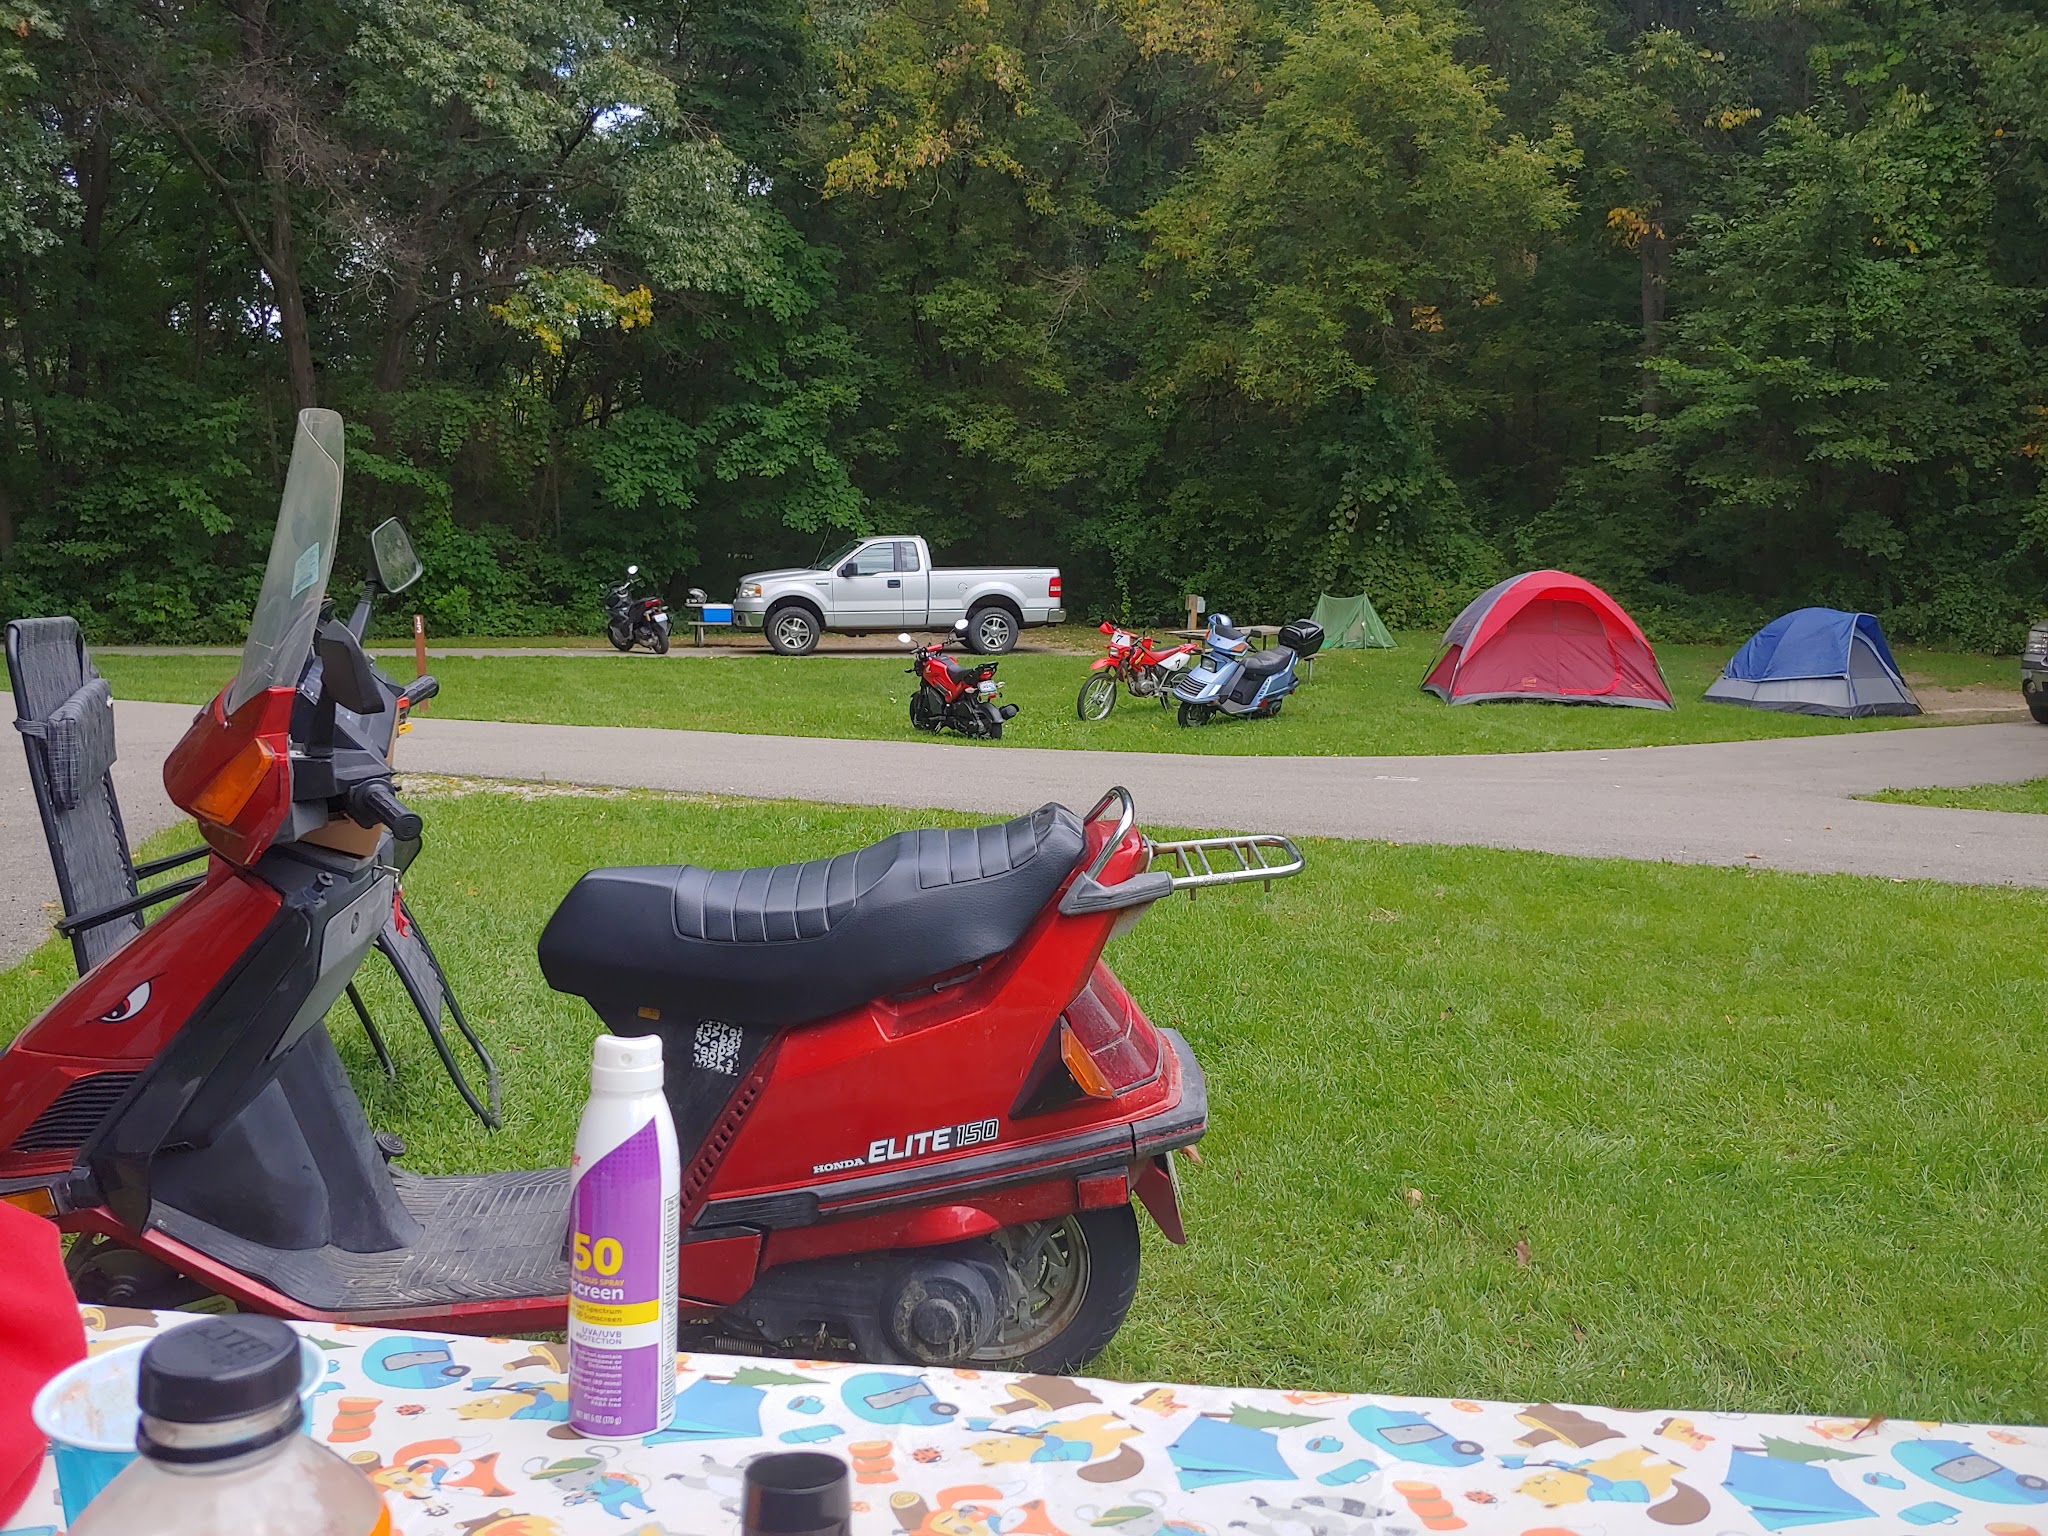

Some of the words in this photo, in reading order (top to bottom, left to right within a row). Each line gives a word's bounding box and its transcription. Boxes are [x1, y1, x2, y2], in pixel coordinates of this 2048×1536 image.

[416, 616, 422, 634] 13
[1115, 634, 1124, 644] 7
[1175, 659, 1182, 669] 7
[706, 1040, 719, 1068] VOID
[813, 1157, 865, 1174] HONDA
[868, 1127, 951, 1164] ELITE
[956, 1118, 999, 1147] 150
[574, 1231, 623, 1277] 50
[599, 1278, 624, 1287] SPRAY
[576, 1332, 622, 1345] PROTECTION
[582, 1326, 622, 1338] UVA/UVB
